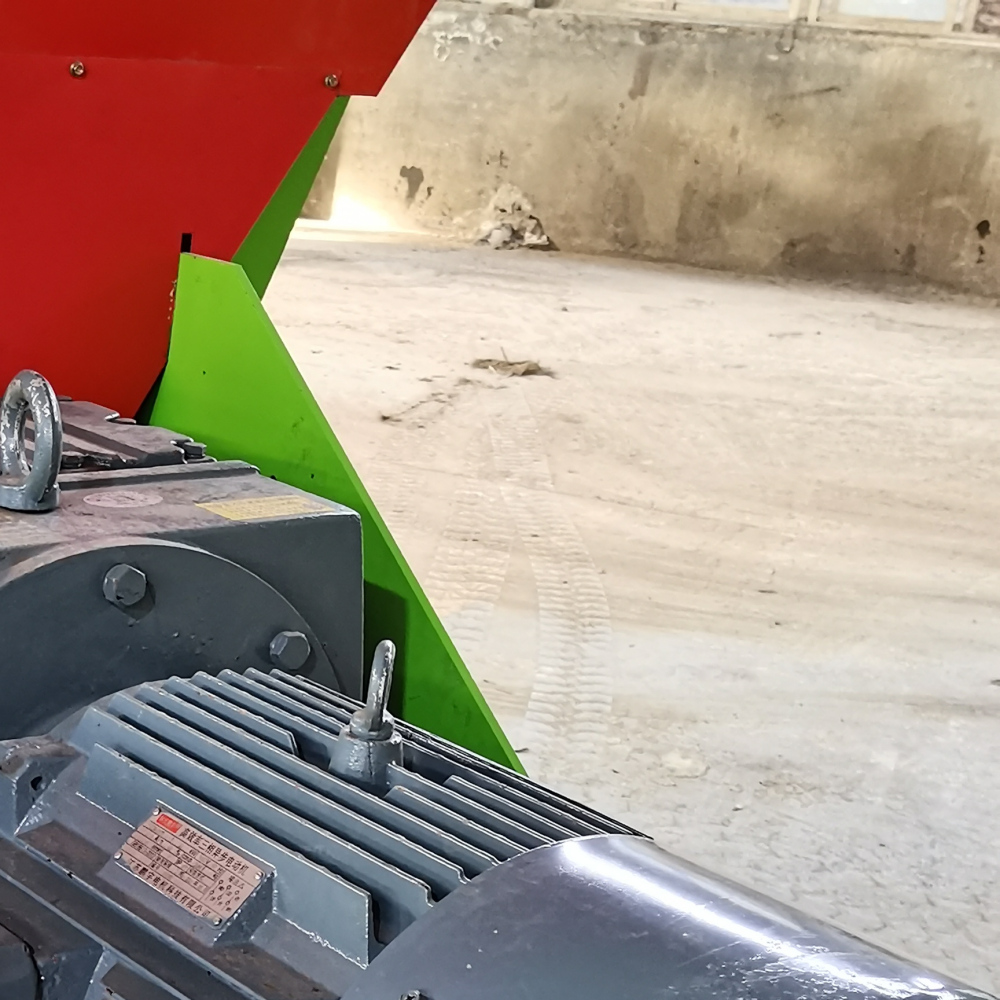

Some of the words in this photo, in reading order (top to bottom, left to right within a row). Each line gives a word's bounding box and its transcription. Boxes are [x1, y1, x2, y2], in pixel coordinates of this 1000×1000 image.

[179, 827, 250, 877] 高效率三相异步电动机
